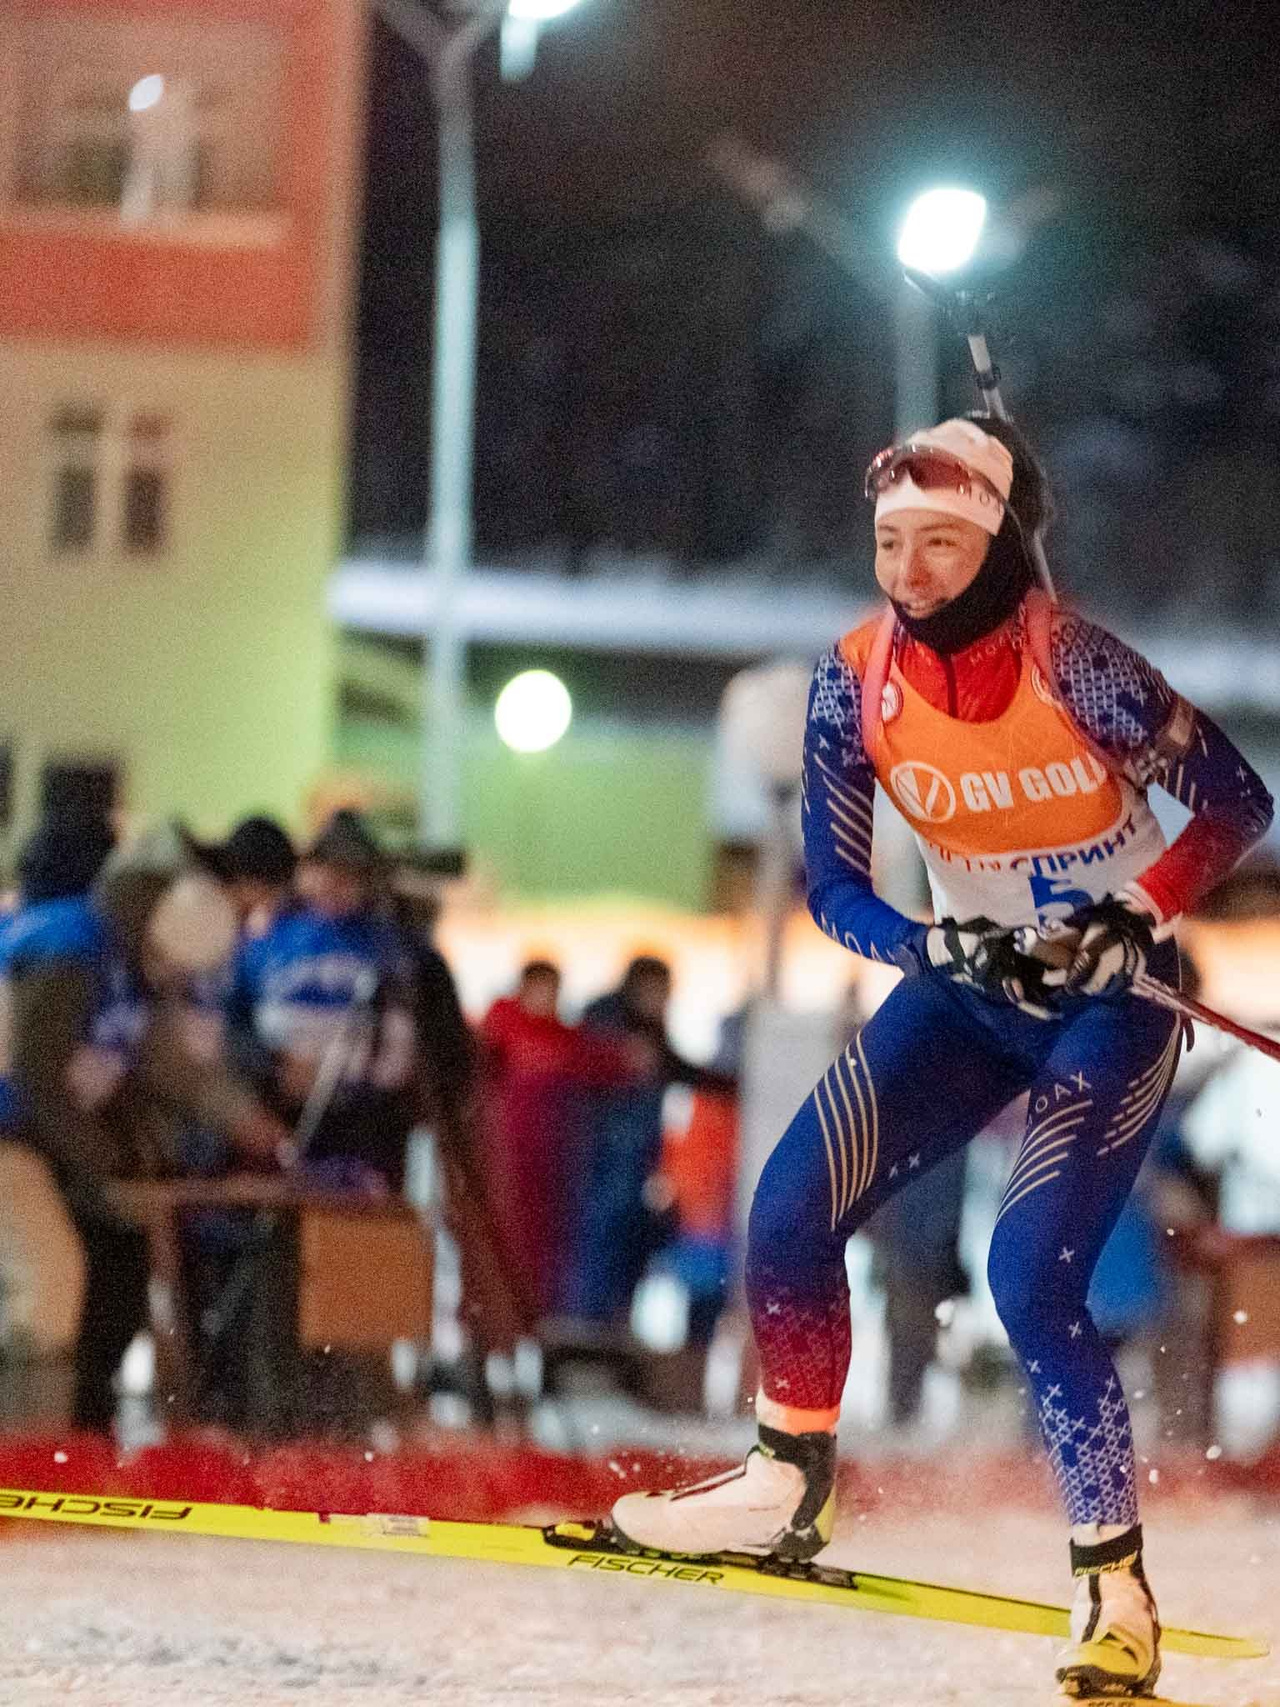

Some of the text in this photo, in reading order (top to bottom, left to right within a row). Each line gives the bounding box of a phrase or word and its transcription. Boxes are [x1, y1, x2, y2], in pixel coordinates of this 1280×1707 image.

[960, 769, 1014, 813] GV
[1027, 1070, 1092, 1129] OAX
[567, 1554, 725, 1586] FISCHER
